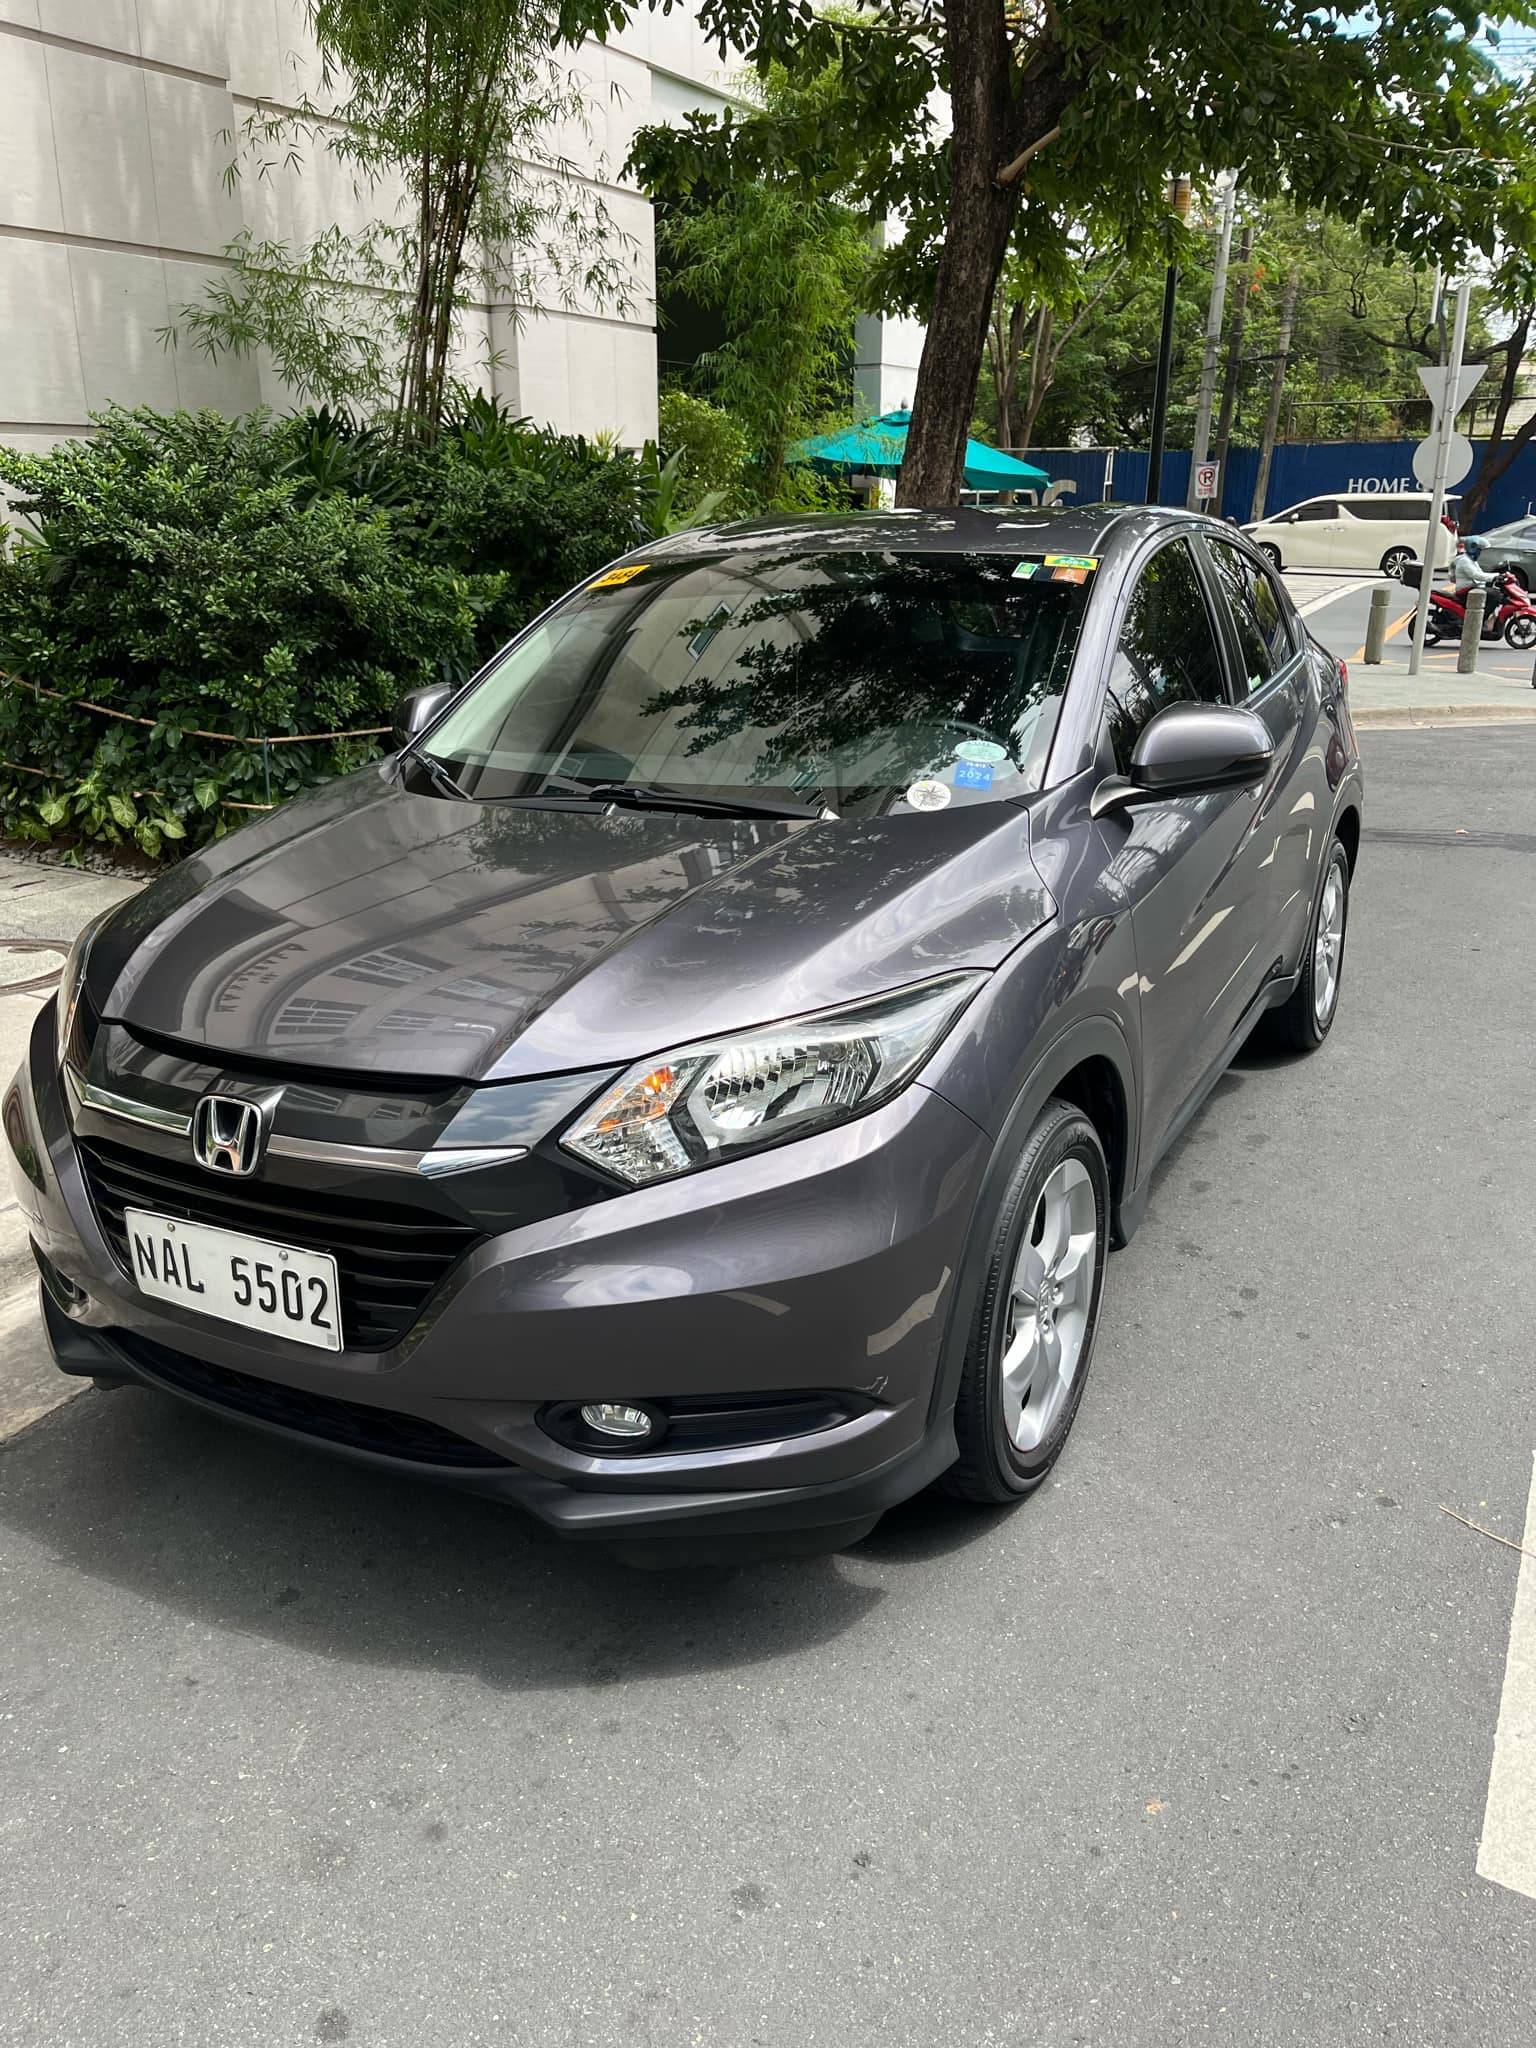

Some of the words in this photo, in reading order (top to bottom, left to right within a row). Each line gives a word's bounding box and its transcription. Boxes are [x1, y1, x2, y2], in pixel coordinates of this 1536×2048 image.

[1348, 478, 1410, 493] HOME
[960, 769, 990, 782] 2024
[133, 1231, 205, 1294] NAL
[230, 1255, 331, 1329] 5502
